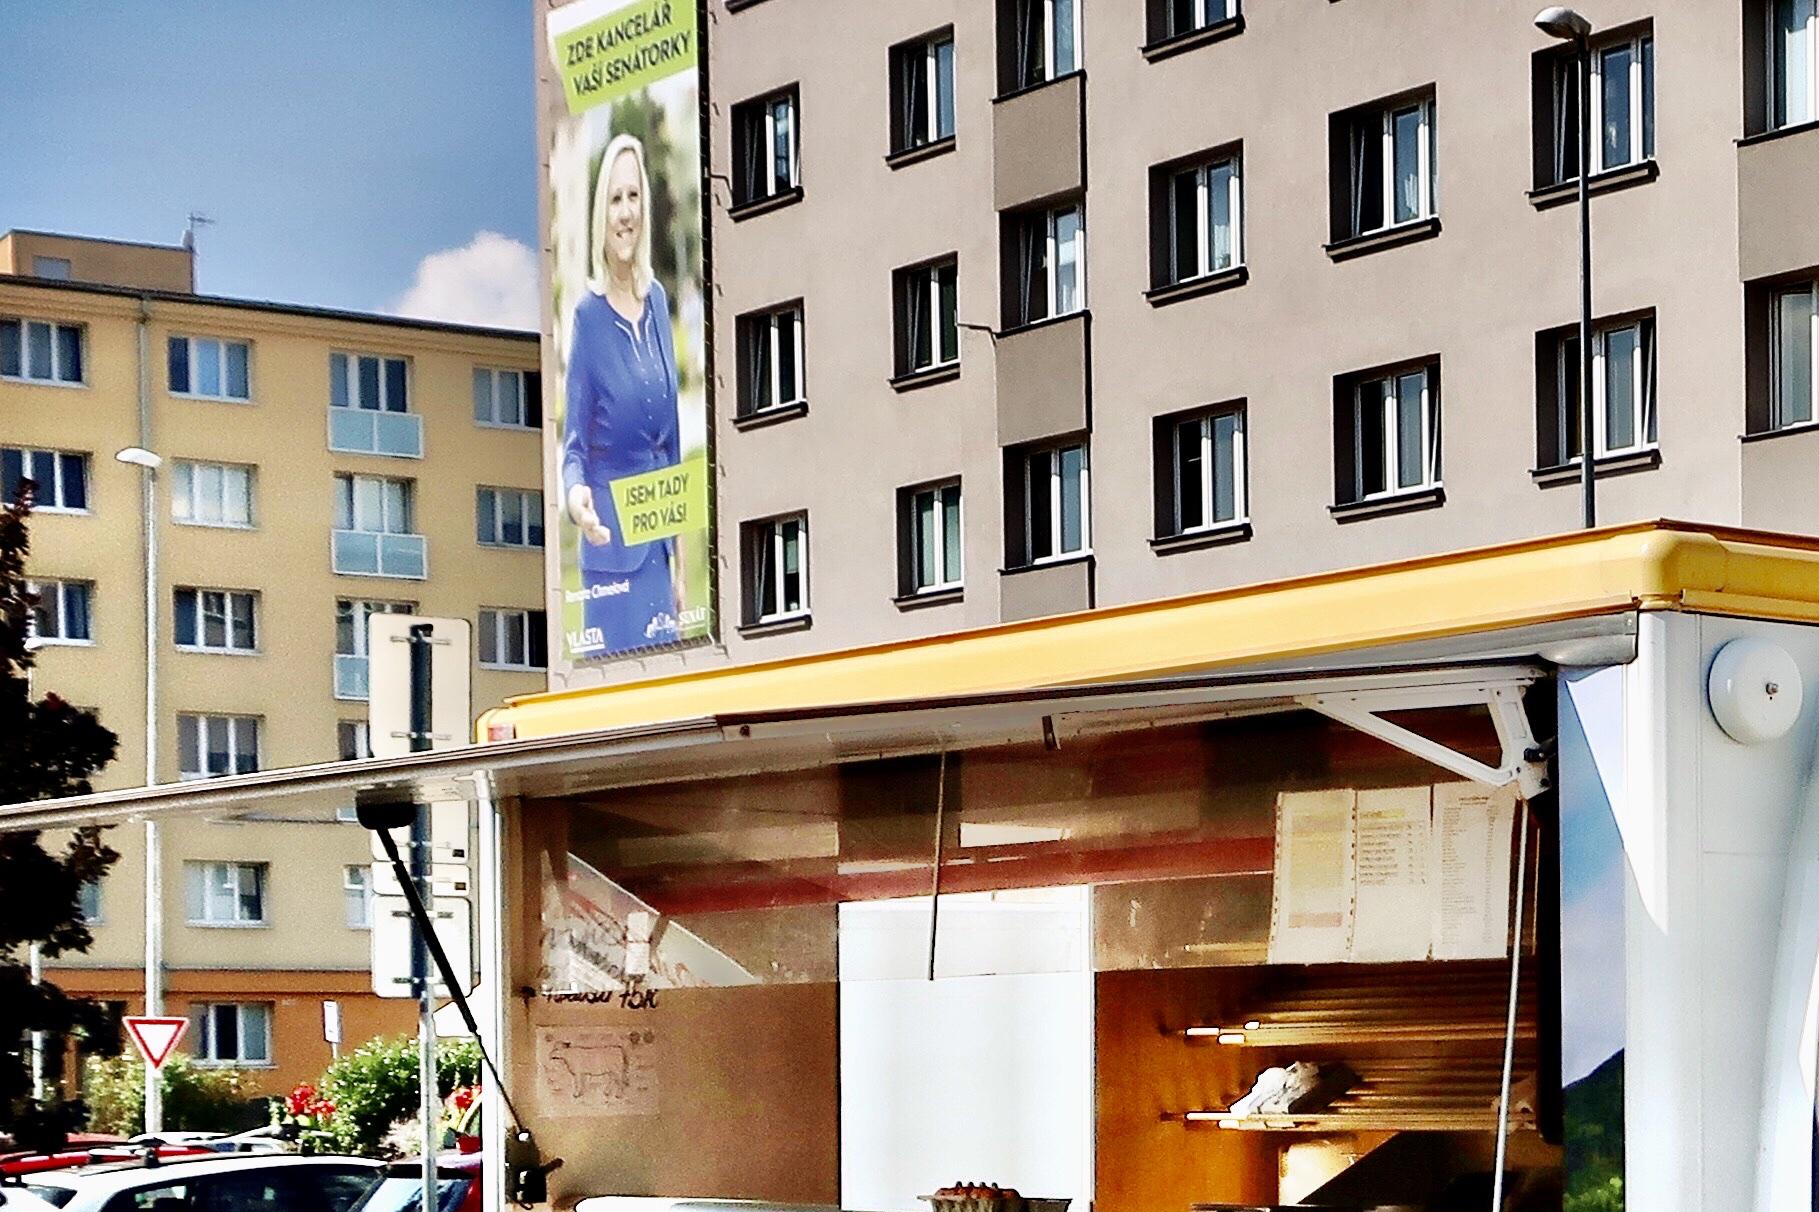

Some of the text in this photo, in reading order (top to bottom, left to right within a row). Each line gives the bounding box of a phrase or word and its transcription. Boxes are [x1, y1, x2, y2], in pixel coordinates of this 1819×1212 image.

[566, 36, 594, 65] ZDE
[605, 30, 690, 86] SENÁTORKY
[625, 473, 690, 507] JSEM TADY
[632, 510, 658, 534] PRO
